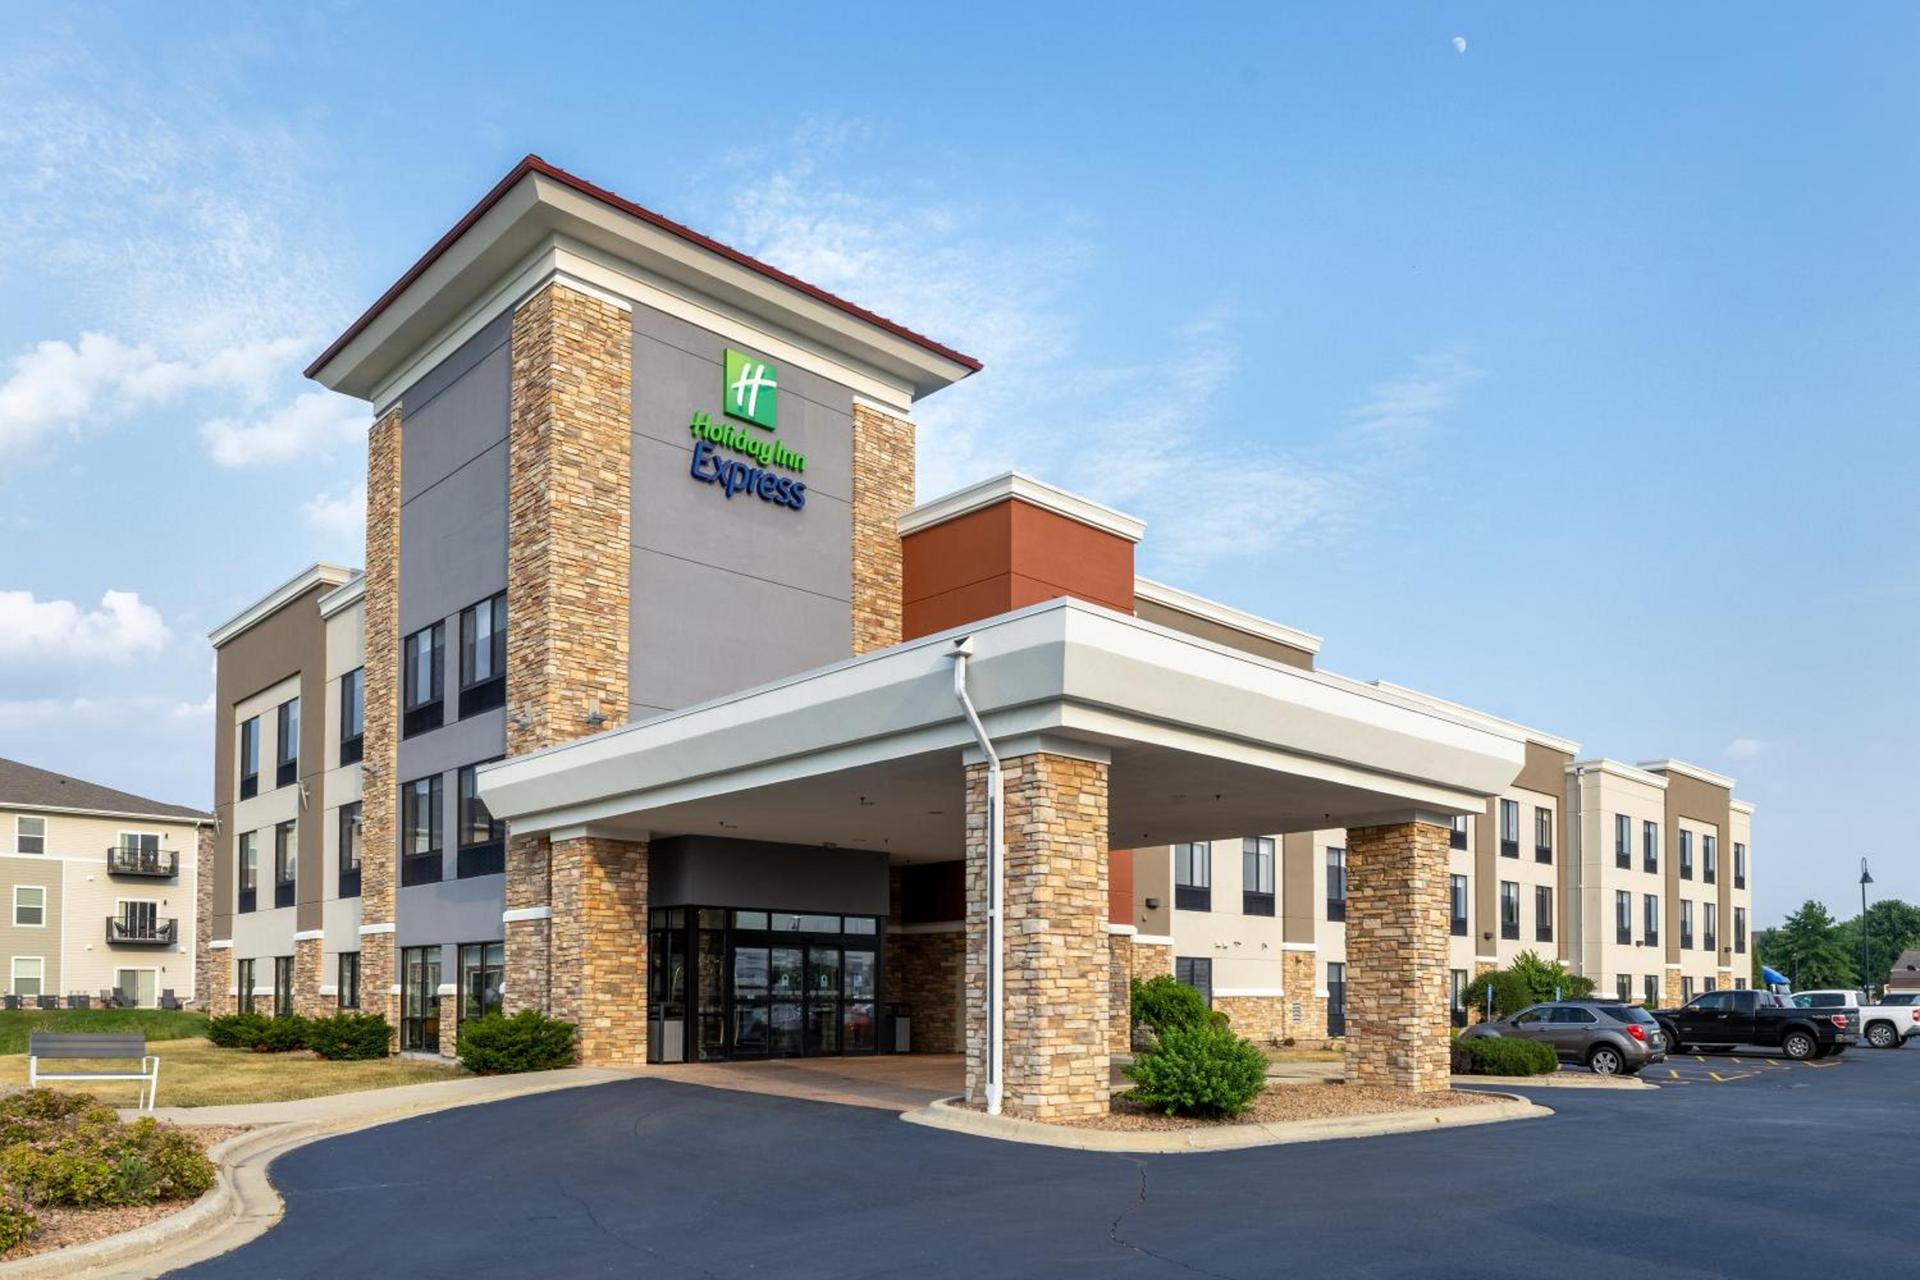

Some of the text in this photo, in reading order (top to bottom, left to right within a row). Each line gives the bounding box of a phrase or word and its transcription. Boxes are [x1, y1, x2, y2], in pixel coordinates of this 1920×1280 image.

[690, 411, 806, 473] Holiday Inn
[690, 440, 807, 511] Express
